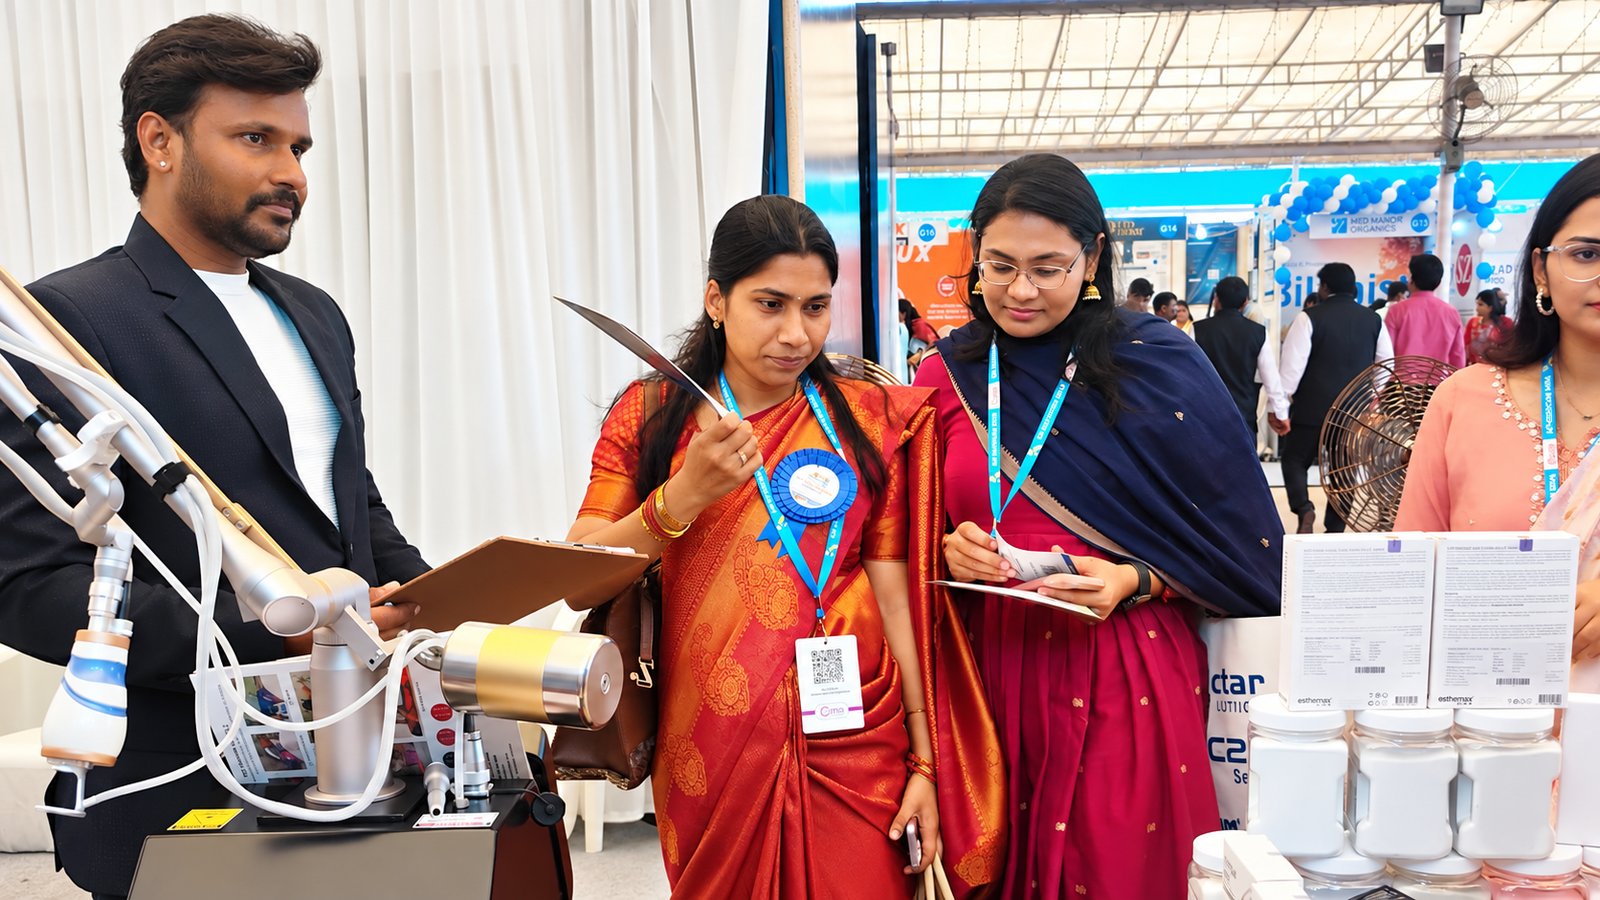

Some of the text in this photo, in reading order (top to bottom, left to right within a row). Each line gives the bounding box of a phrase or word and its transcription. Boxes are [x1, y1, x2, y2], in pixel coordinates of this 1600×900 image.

[1350, 215, 1403, 225] MED MANOR
[920, 228, 936, 237] G16
[1160, 224, 1178, 233] G14
[1350, 224, 1397, 233] ORGANICS
